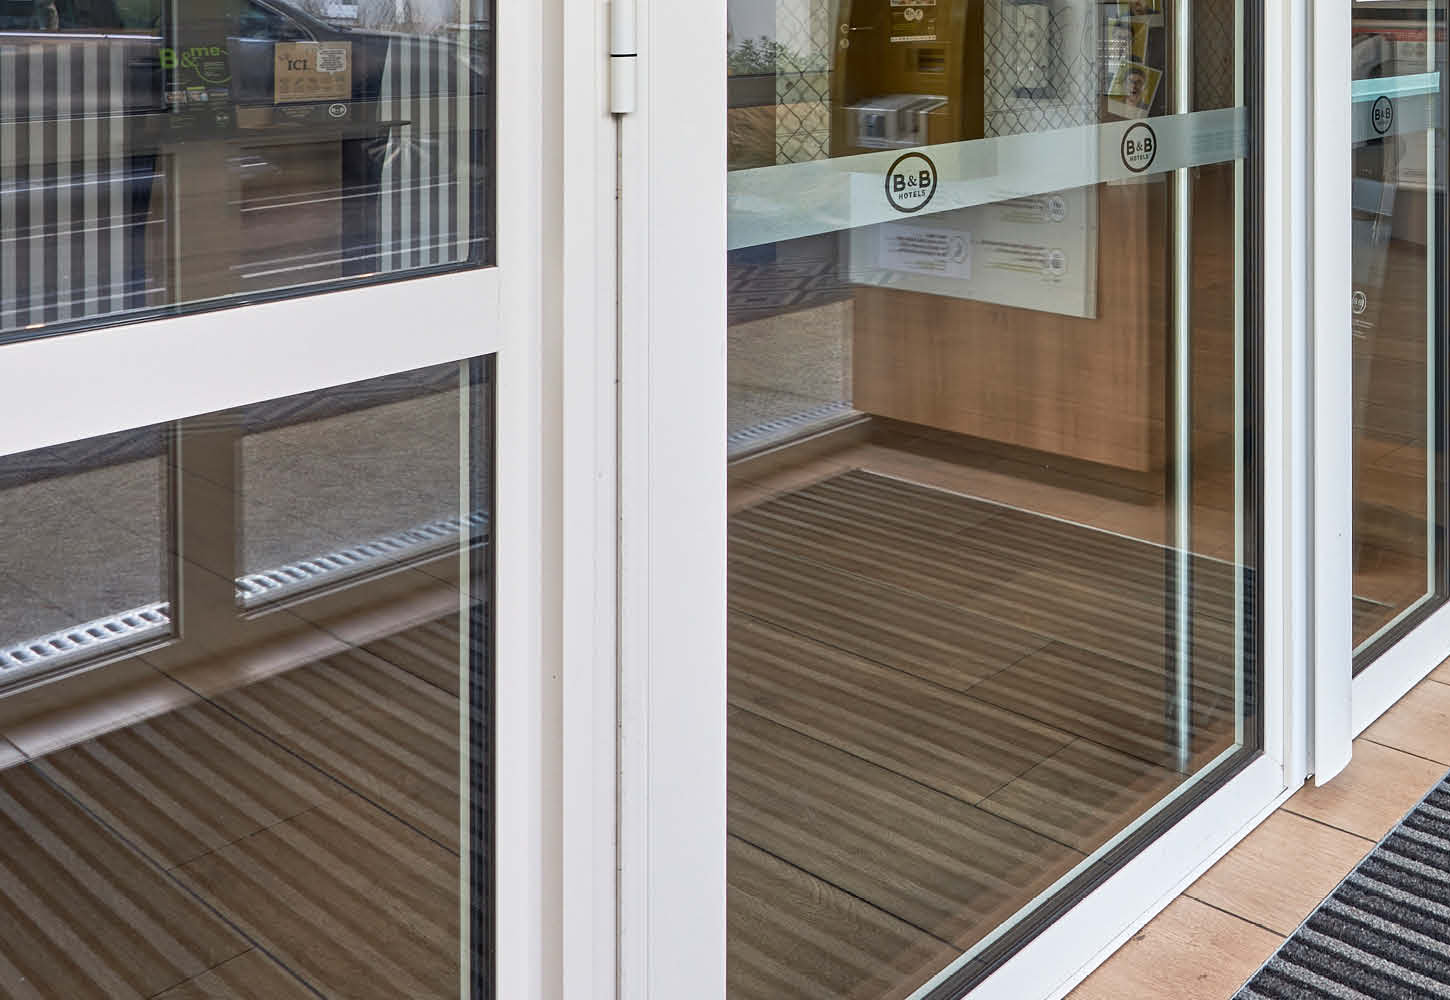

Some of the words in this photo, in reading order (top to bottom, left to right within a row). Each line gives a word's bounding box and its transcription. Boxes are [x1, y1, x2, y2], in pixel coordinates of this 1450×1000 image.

[1127, 138, 1152, 155] B&B
[893, 170, 931, 192] B&B
[899, 190, 926, 200] HOTELS
